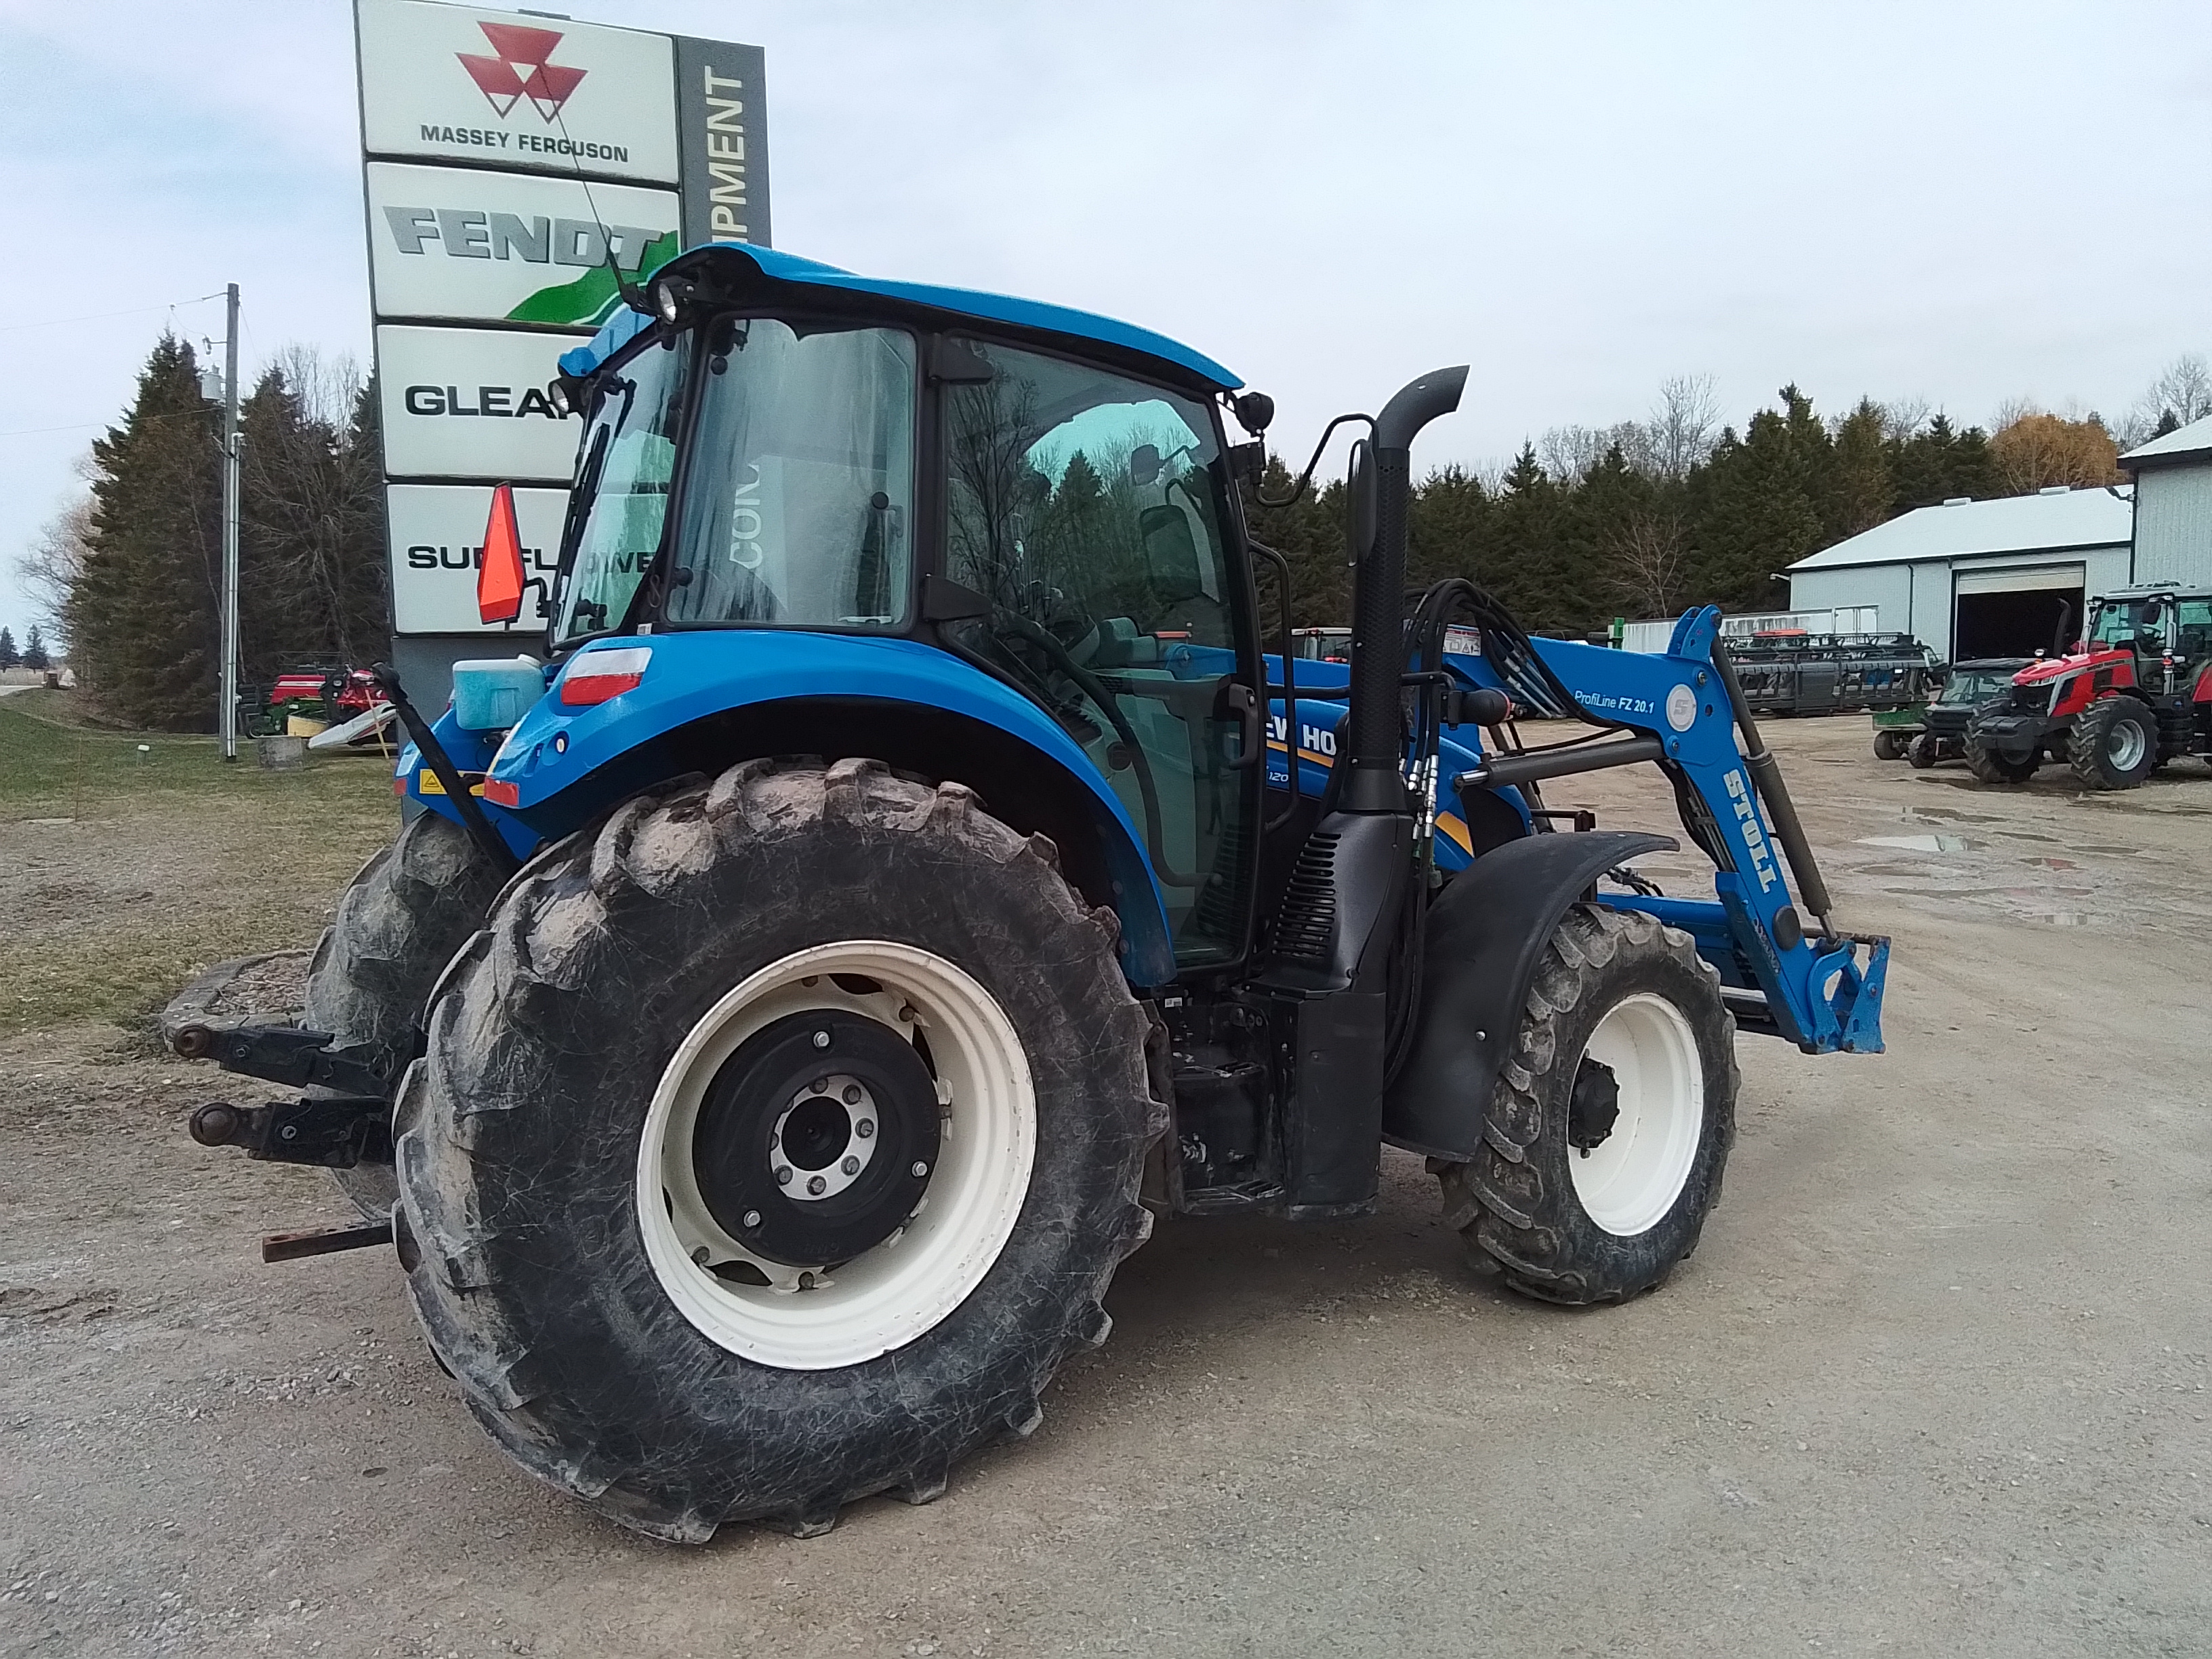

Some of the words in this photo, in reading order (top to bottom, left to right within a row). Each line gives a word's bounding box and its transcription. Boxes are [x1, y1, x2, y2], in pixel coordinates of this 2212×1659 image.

[420, 124, 510, 148] MASSEY
[518, 134, 628, 162] FERGUSON
[382, 206, 663, 272] FENDT
[405, 386, 568, 419] GLEA
[729, 463, 763, 569] CON
[1575, 690, 1616, 708] ProfiLine
[1618, 697, 1633, 711] FZ
[1633, 699, 1655, 714] 20.1
[1303, 724, 1337, 756] HO
[1269, 771, 1289, 782] 120
[1723, 769, 1777, 894] STOLL
